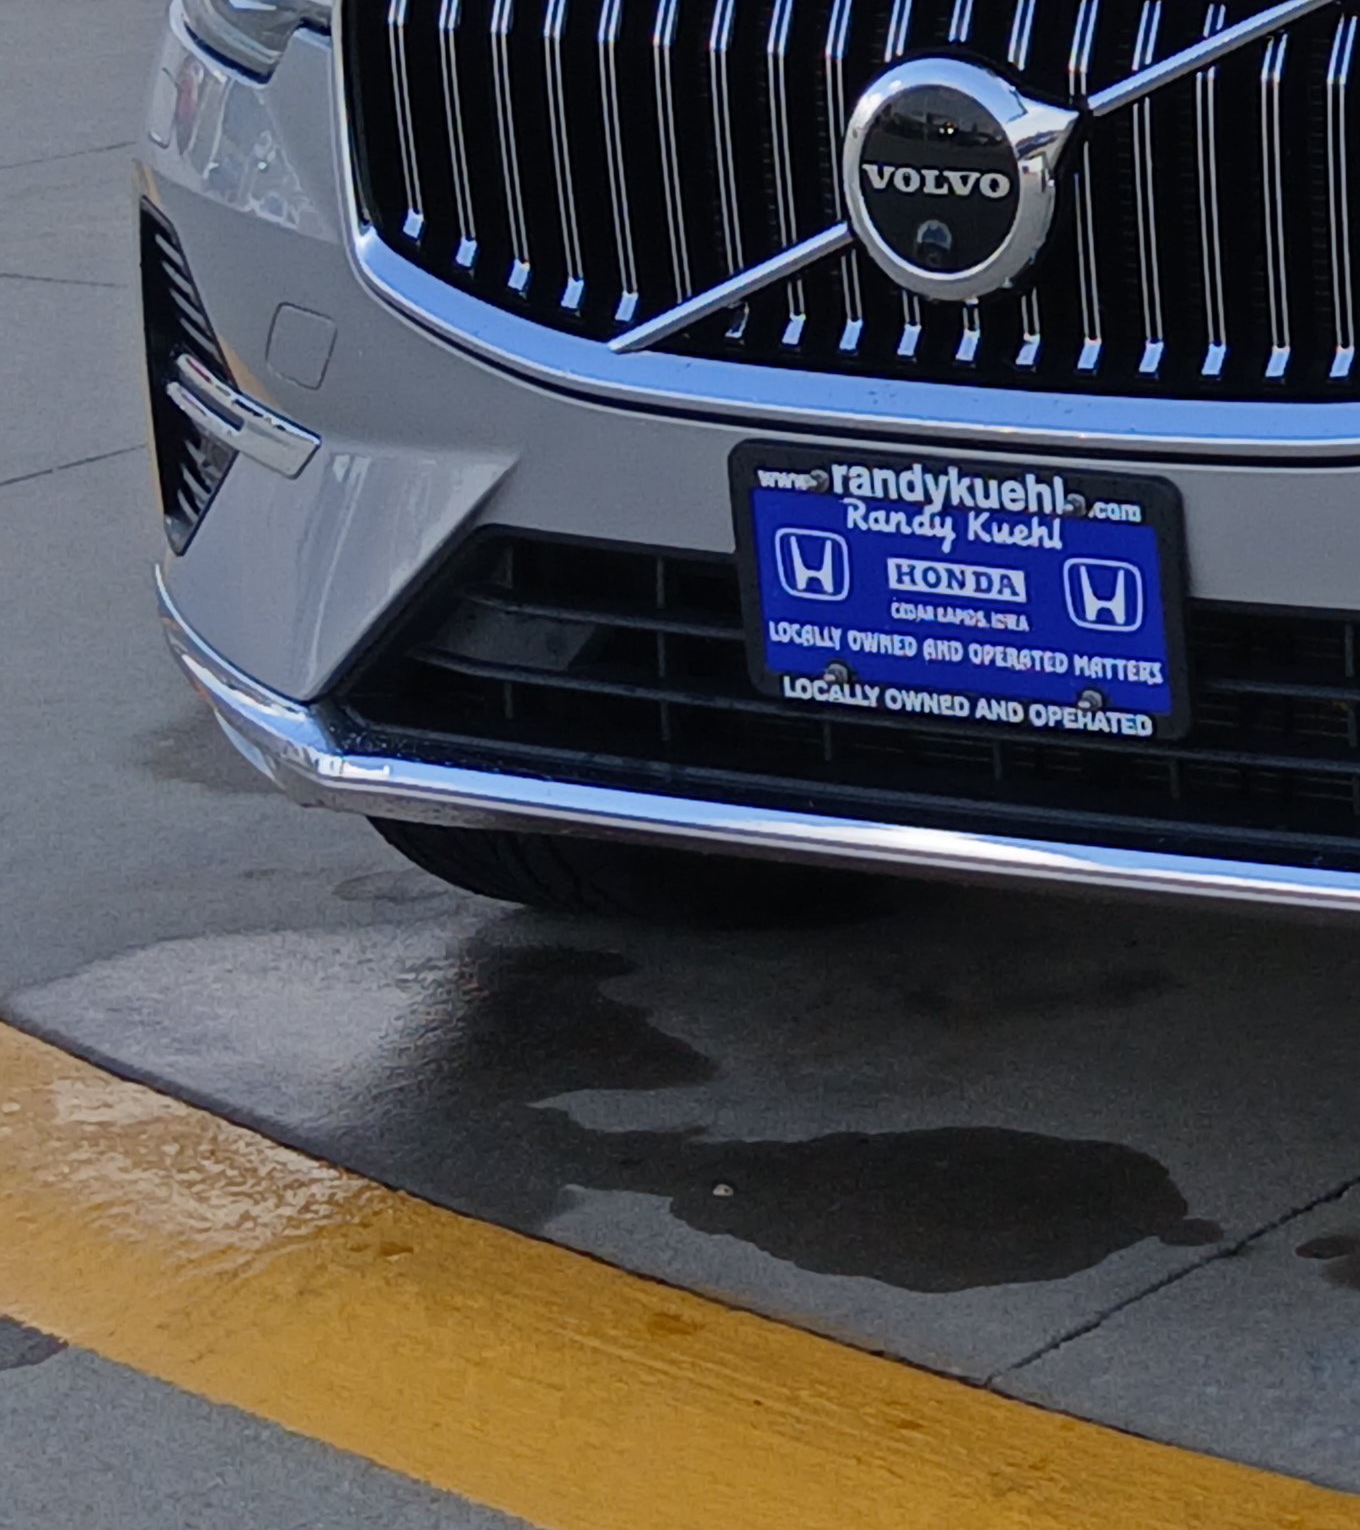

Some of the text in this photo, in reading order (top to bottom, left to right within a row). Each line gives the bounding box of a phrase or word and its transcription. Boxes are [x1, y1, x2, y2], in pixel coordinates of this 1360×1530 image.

[862, 164, 1011, 198] VOLVO
[839, 498, 1063, 553] Randy Kuehl
[895, 563, 1020, 597] HONDA
[769, 621, 1164, 685] LOCALLY OWNED AND OPERATED MATTERS
[783, 676, 880, 708] LOCALLY
[884, 688, 970, 717] OWNED
[975, 698, 1024, 723] AND
